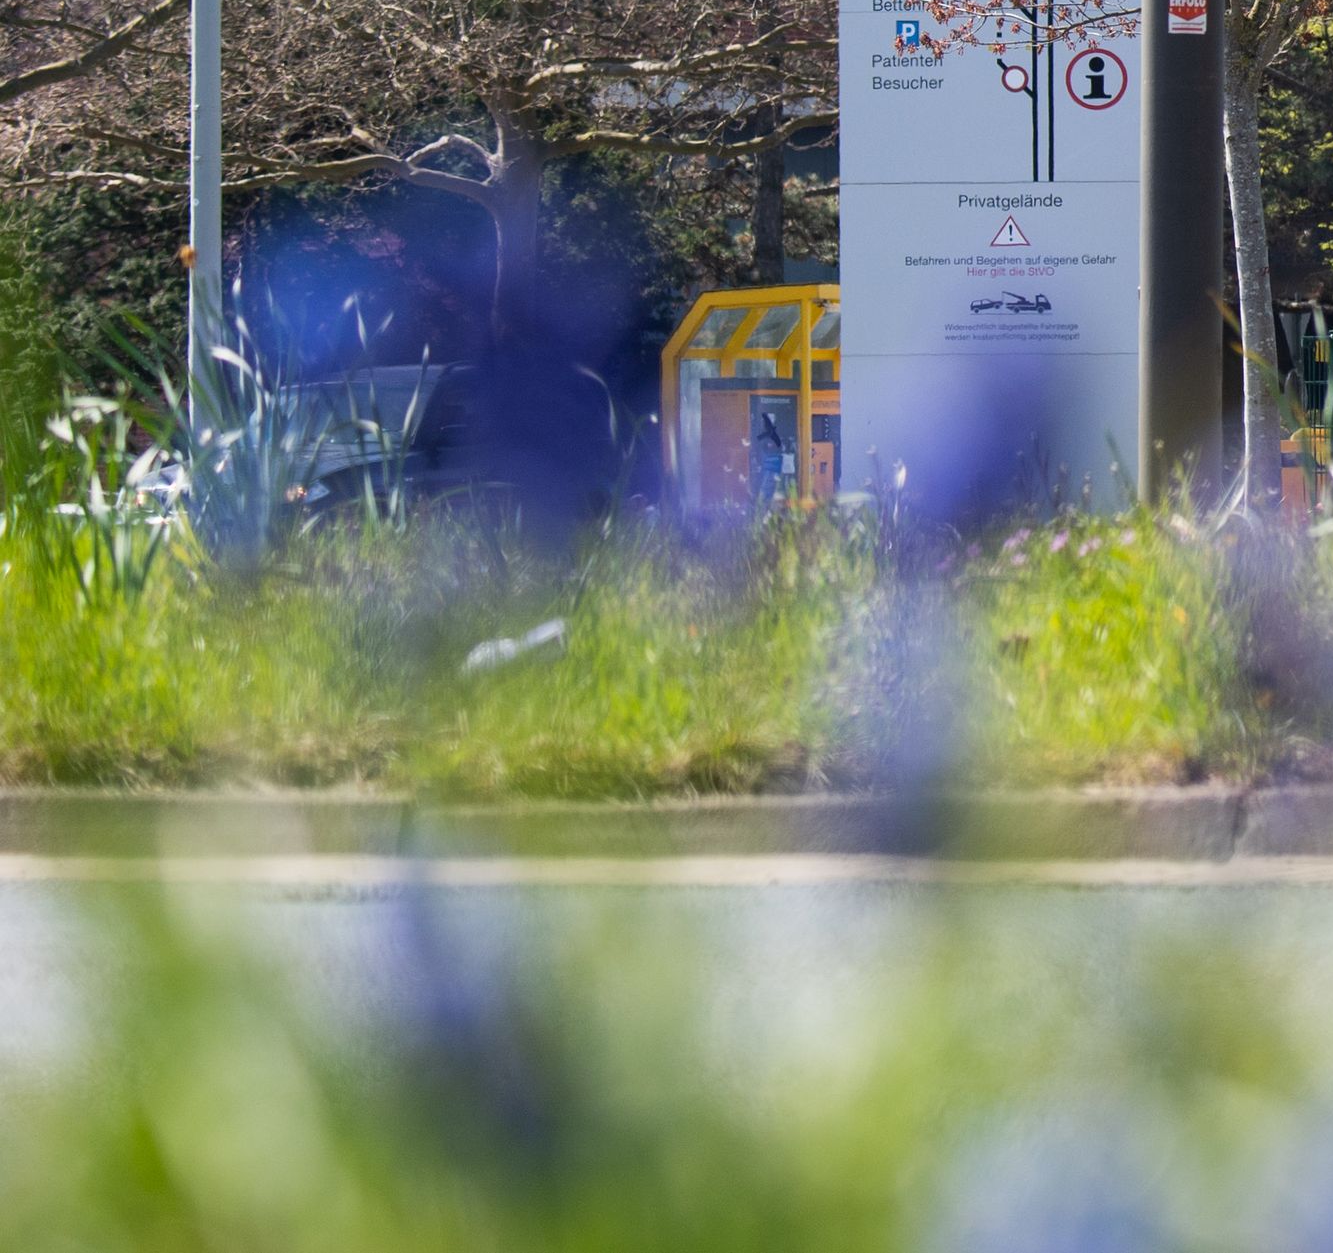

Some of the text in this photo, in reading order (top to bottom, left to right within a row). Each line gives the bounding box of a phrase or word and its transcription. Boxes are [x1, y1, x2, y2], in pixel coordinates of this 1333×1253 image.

[872, 54, 944, 68] Patienten
[872, 76, 944, 90] Besucher
[958, 193, 1063, 212] Privatgelände
[905, 254, 1117, 268] Befahren und Begehen auf eigene Gefahr
[966, 267, 987, 277] Hier
[1009, 266, 1026, 277] die
[1028, 266, 1056, 277] StVO
